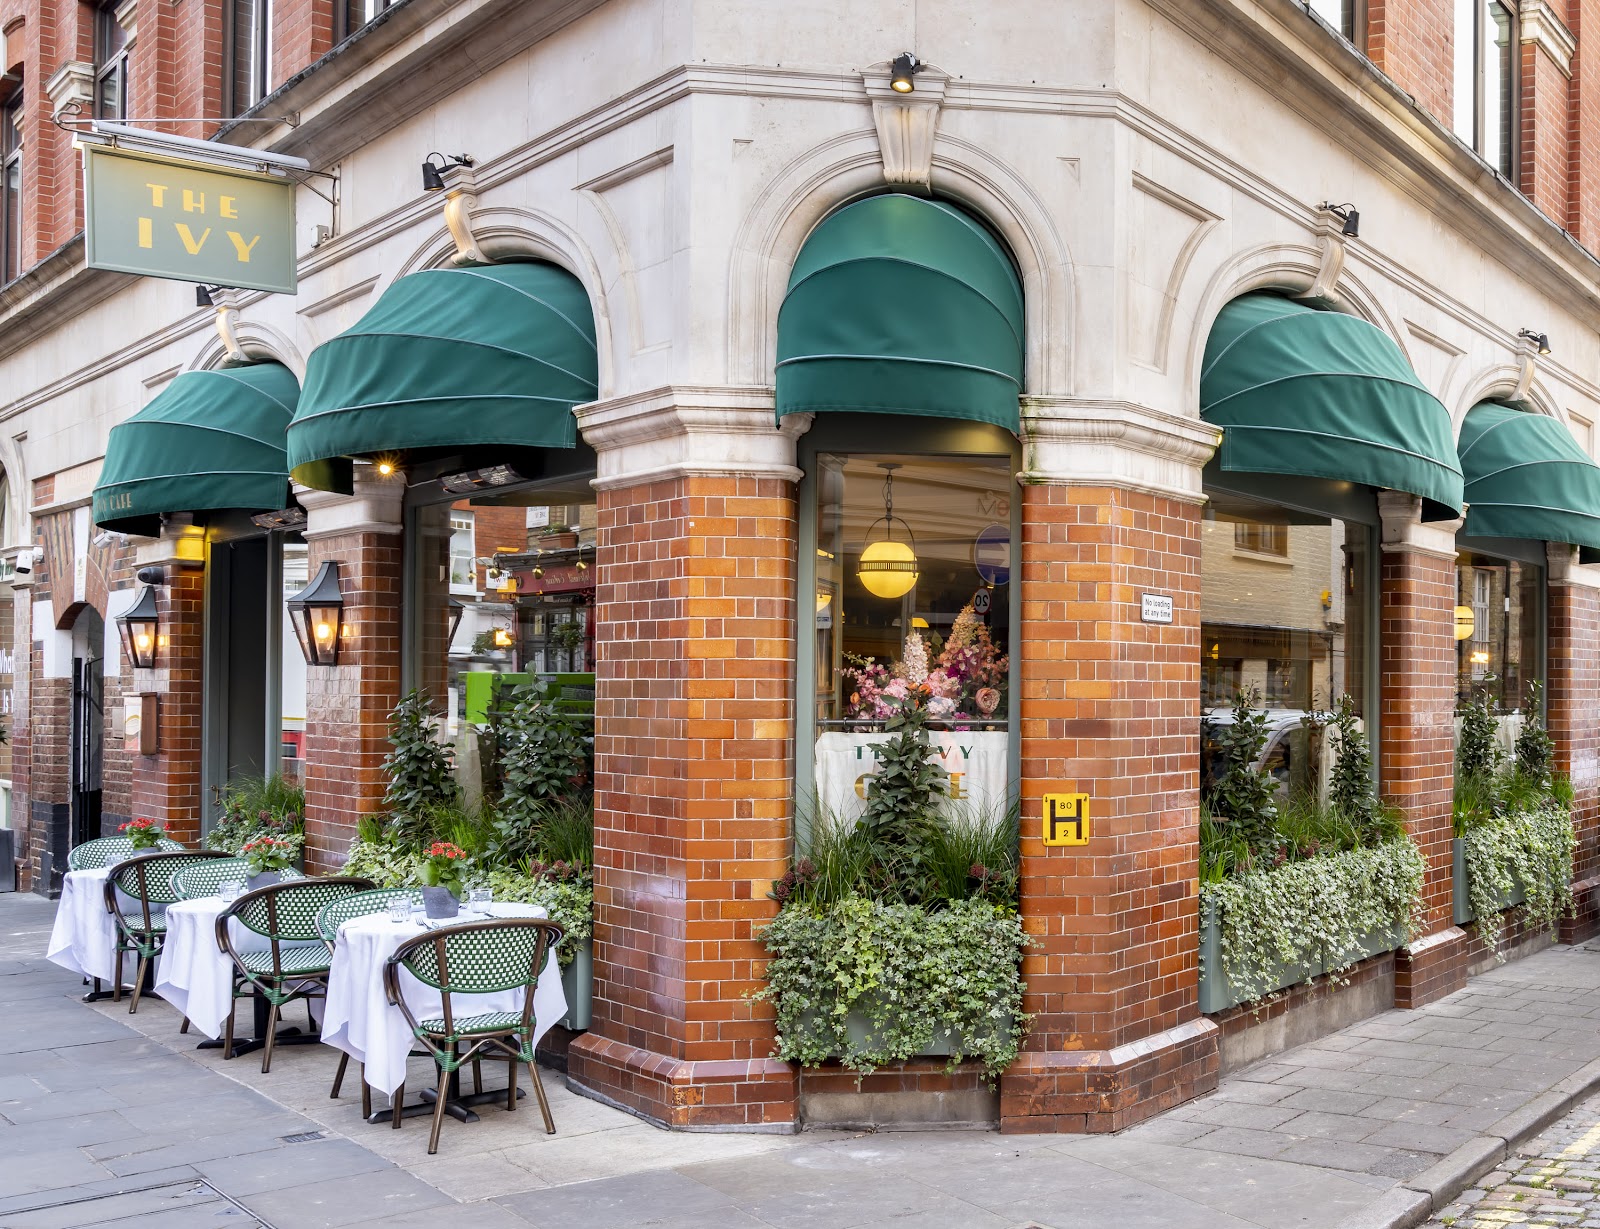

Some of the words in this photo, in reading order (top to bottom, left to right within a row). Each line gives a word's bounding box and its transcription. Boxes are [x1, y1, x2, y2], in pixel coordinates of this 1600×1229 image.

[146, 183, 238, 219] THE
[139, 217, 260, 262] IVY
[1145, 598, 1152, 606] No
[1153, 600, 1170, 609] loading
[1150, 610, 1160, 618] any
[1059, 801, 1073, 810] 80
[1049, 799, 1083, 841] H
[1063, 829, 1069, 838] 2
